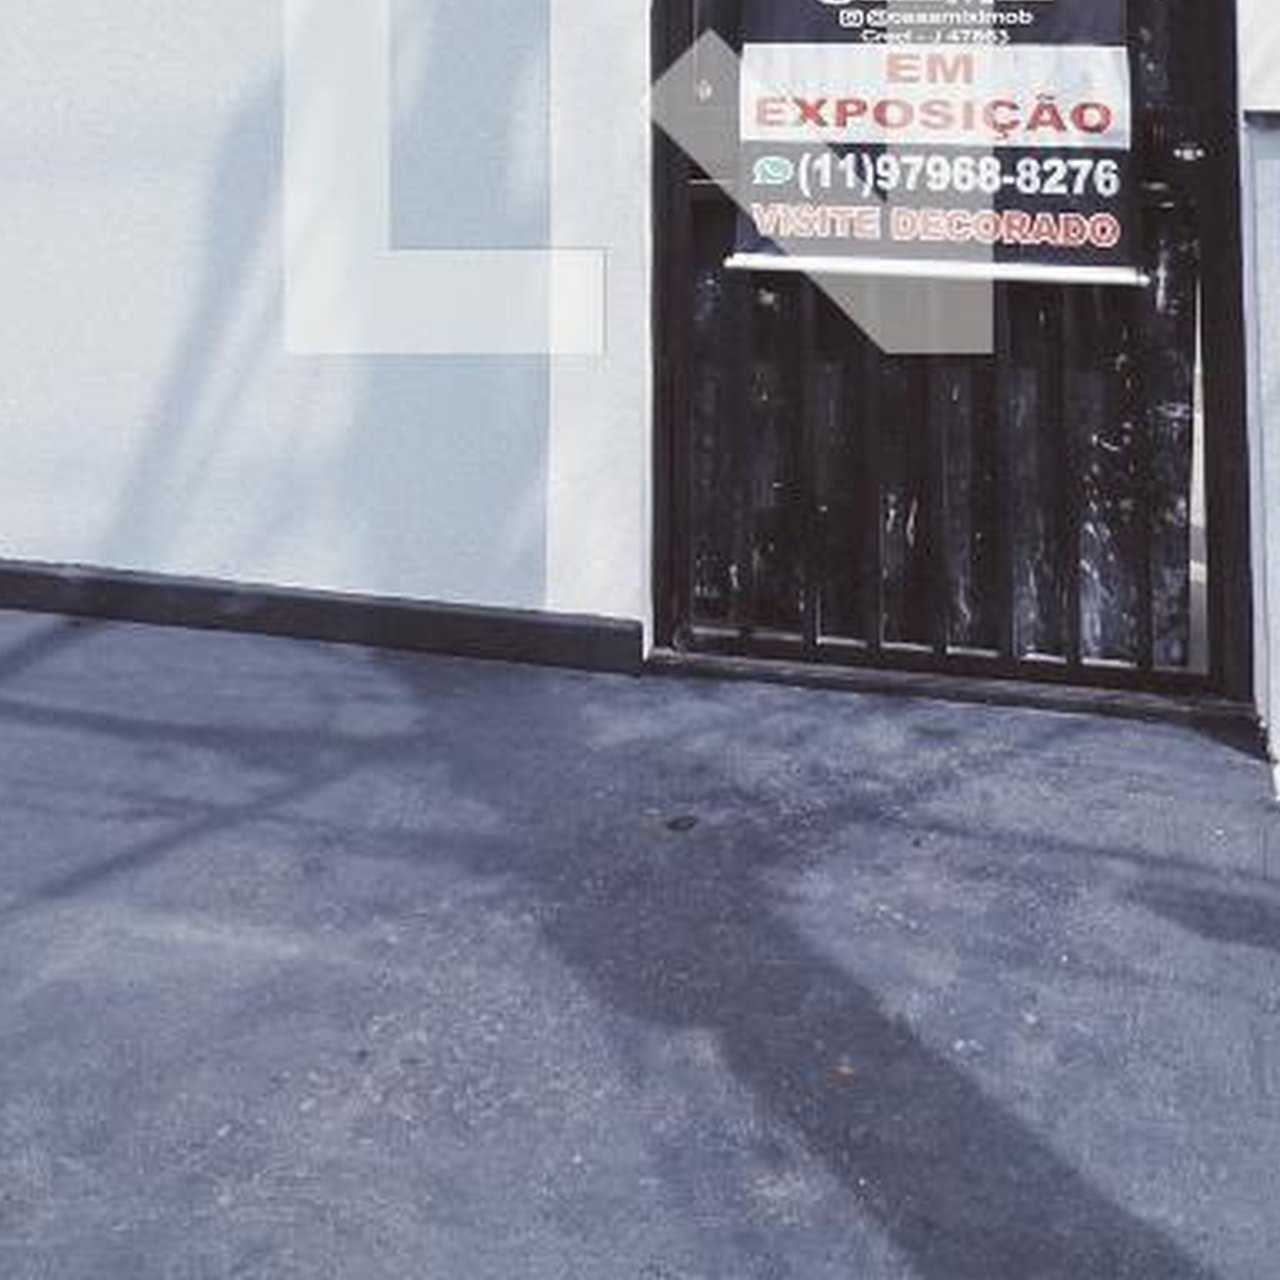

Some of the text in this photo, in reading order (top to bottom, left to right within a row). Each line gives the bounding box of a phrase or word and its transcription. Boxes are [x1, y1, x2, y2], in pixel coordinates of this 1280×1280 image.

[885, 53, 974, 84] EM
[755, 94, 1114, 140] EXPOSIÇÃO
[797, 153, 1120, 198] (11)97968-8276
[751, 202, 1120, 248] VISITE DECORADO
